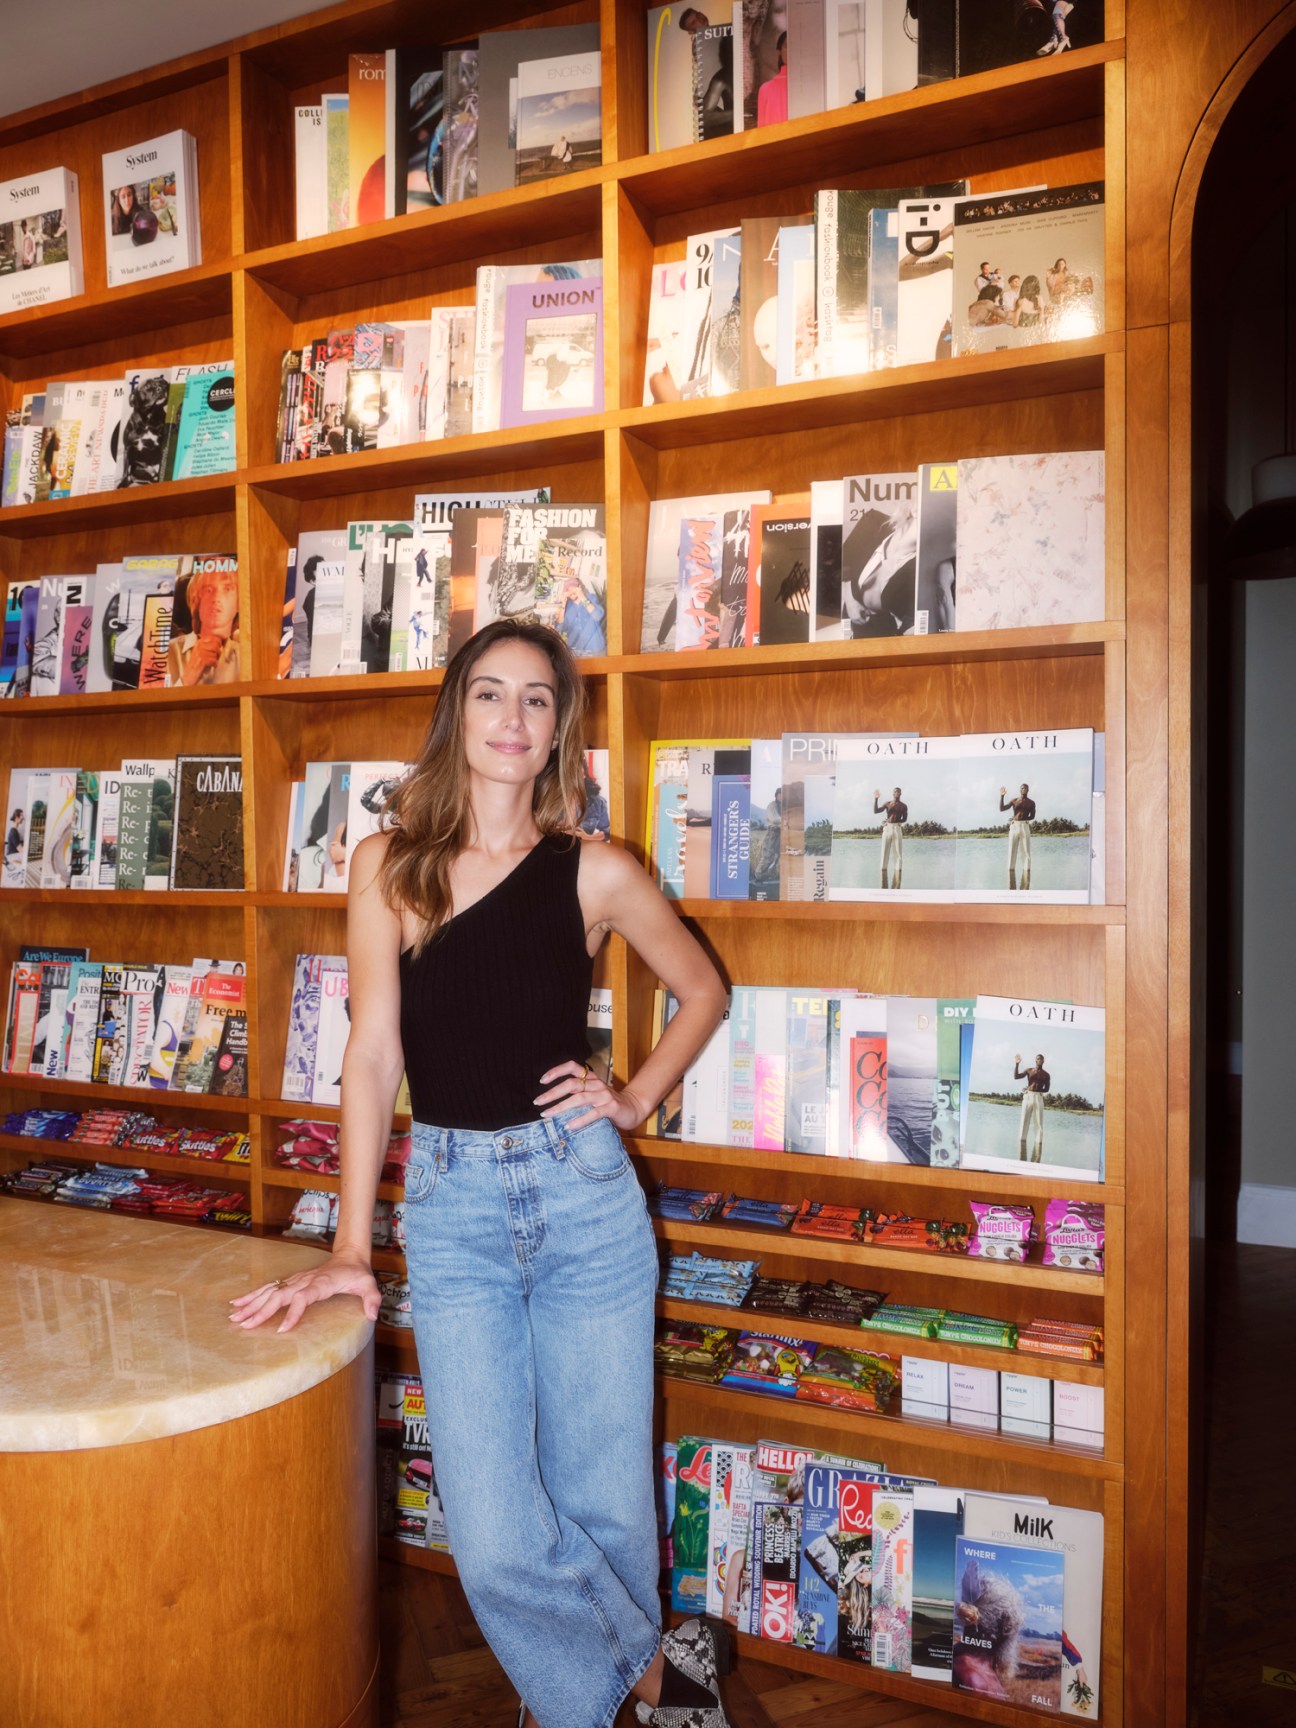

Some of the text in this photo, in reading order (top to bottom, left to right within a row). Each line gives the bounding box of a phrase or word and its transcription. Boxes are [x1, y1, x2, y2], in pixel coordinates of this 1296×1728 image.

[547, 63, 592, 79] ENCENS
[298, 109, 323, 118] COLL
[126, 150, 158, 170] System
[9, 183, 40, 203] System
[824, 190, 834, 218] rouge
[822, 223, 833, 283] fashionbook
[482, 268, 492, 295] rouge
[532, 289, 595, 309] UNION
[479, 297, 490, 351] fashionbook
[28, 431, 43, 489] JACKDAW
[508, 508, 597, 528] FASHION
[506, 527, 548, 545] FOR
[506, 544, 536, 563] ME
[557, 545, 602, 558] Record
[143, 607, 173, 684] WatchTime
[867, 741, 929, 756] OATH
[992, 735, 1057, 751] OATH
[727, 800, 740, 879] STRANGER'S
[739, 818, 750, 861] GUIDE
[813, 860, 826, 901] Regain
[23, 951, 40, 961] Are
[40, 952, 53, 961] We
[208, 987, 240, 998] Economist
[205, 1004, 233, 1017] Free
[944, 1007, 969, 1018] DIY
[1009, 1003, 1076, 1023] OATH
[230, 1020, 242, 1029] The
[46, 1049, 59, 1077] New
[179, 1140, 216, 1153] Skittles
[979, 1222, 1021, 1234] NUGGLETS
[1052, 1233, 1096, 1244] NUGGLETS
[906, 1371, 924, 1380] RELAX
[954, 1382, 975, 1391] DREAM
[1006, 1386, 1028, 1394] POWER
[1059, 1393, 1080, 1402] BOOST
[736, 1452, 748, 1463] THE
[757, 1446, 814, 1471] HELLO!
[754, 1530, 762, 1560] SOUVENIR
[764, 1523, 775, 1563] PRINCESS
[774, 1523, 784, 1564] BEATRICE
[1008, 1533, 1077, 1553] COLLECTIONS
[964, 1548, 996, 1561] WHERE
[753, 1561, 761, 1588] WEDDING
[752, 1589, 760, 1609] ROYAL
[763, 1583, 788, 1639] OK!
[1038, 1604, 1055, 1614] THE
[960, 1635, 992, 1649] LEAVES
[1031, 1695, 1053, 1707] FALL
